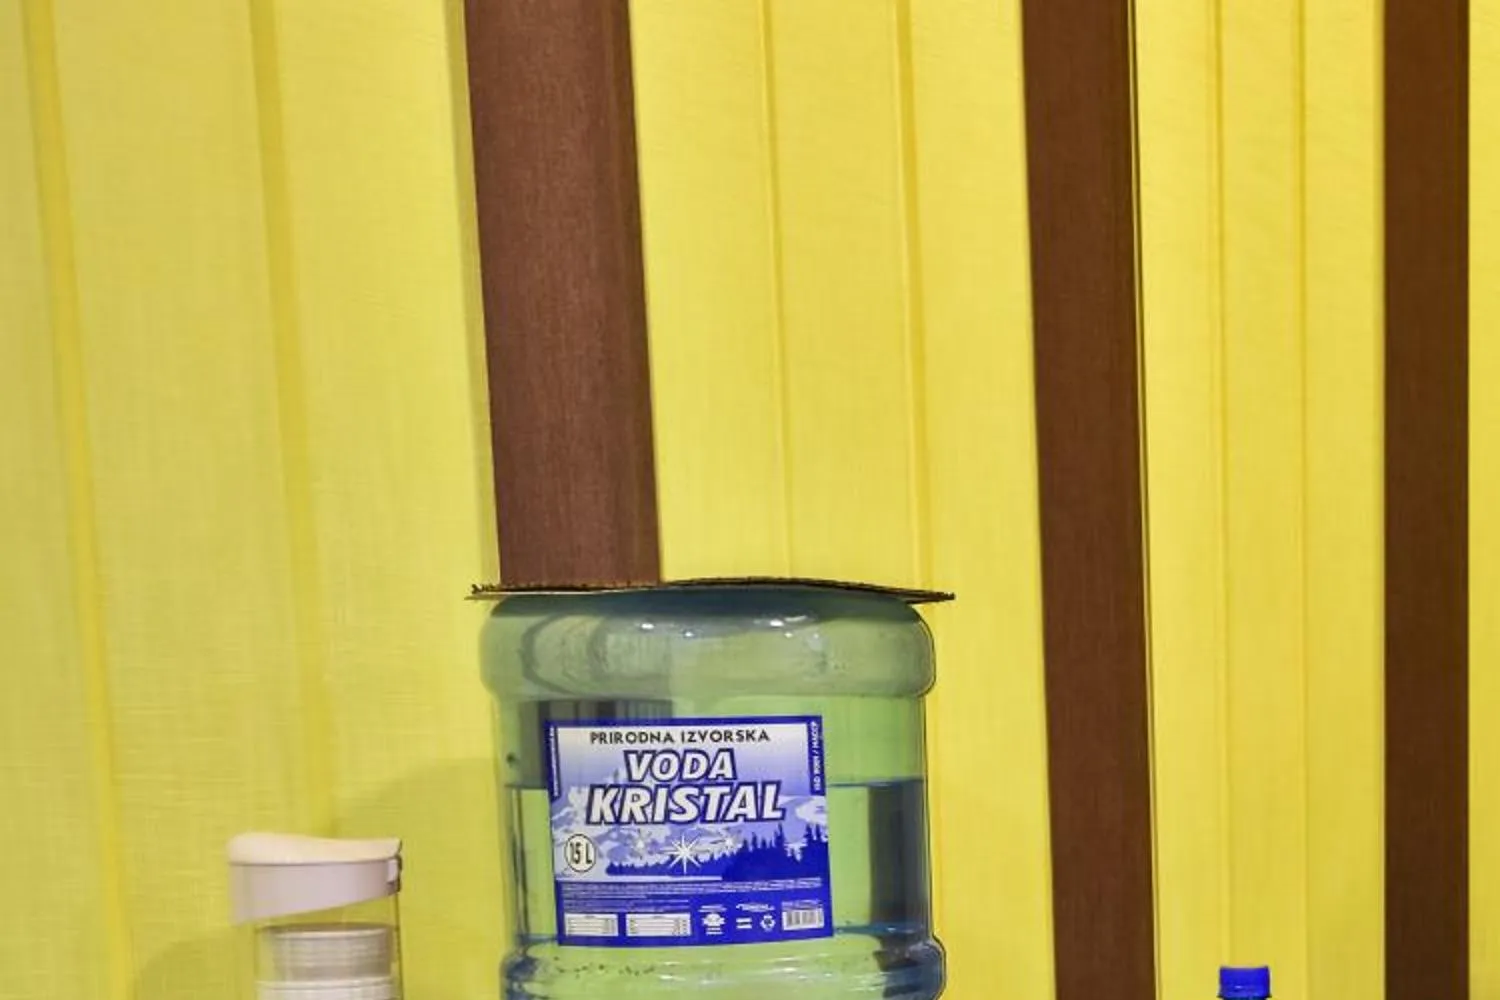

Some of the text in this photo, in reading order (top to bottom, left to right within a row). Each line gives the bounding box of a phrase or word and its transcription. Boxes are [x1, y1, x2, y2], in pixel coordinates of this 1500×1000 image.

[590, 729, 770, 745] PRIRODNA IZVORSKA
[625, 748, 738, 782] VODA
[586, 780, 787, 825] KRISTAL
